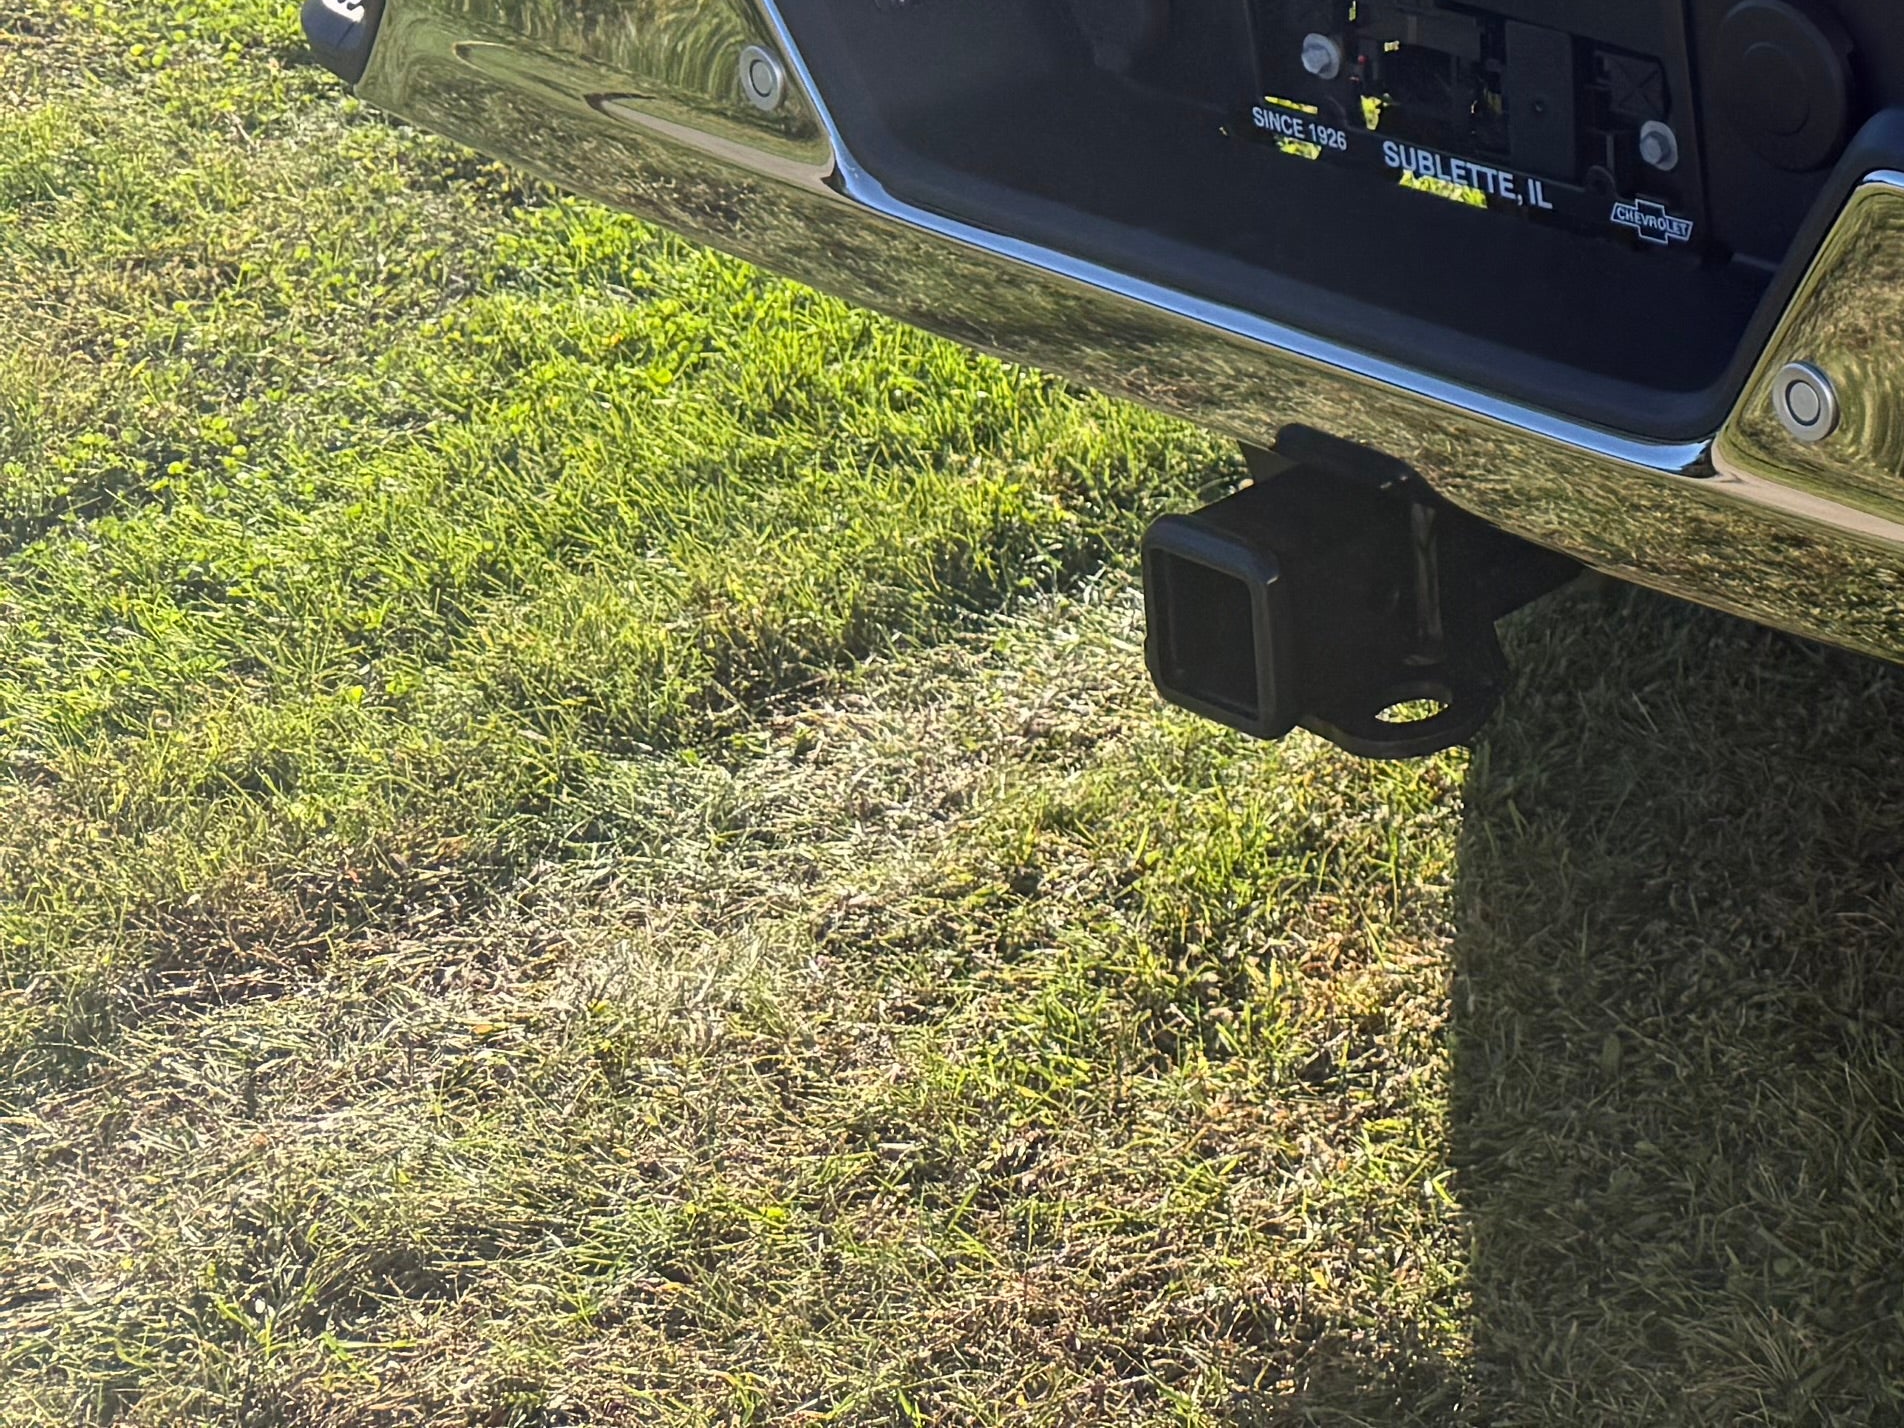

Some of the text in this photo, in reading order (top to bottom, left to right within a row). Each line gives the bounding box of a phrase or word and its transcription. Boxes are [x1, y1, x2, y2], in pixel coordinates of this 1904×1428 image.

[1252, 106, 1348, 152] SINCE 1926
[1382, 140, 1553, 210] SUBLETTE, IL
[1616, 205, 1688, 237] CHEVROLET
